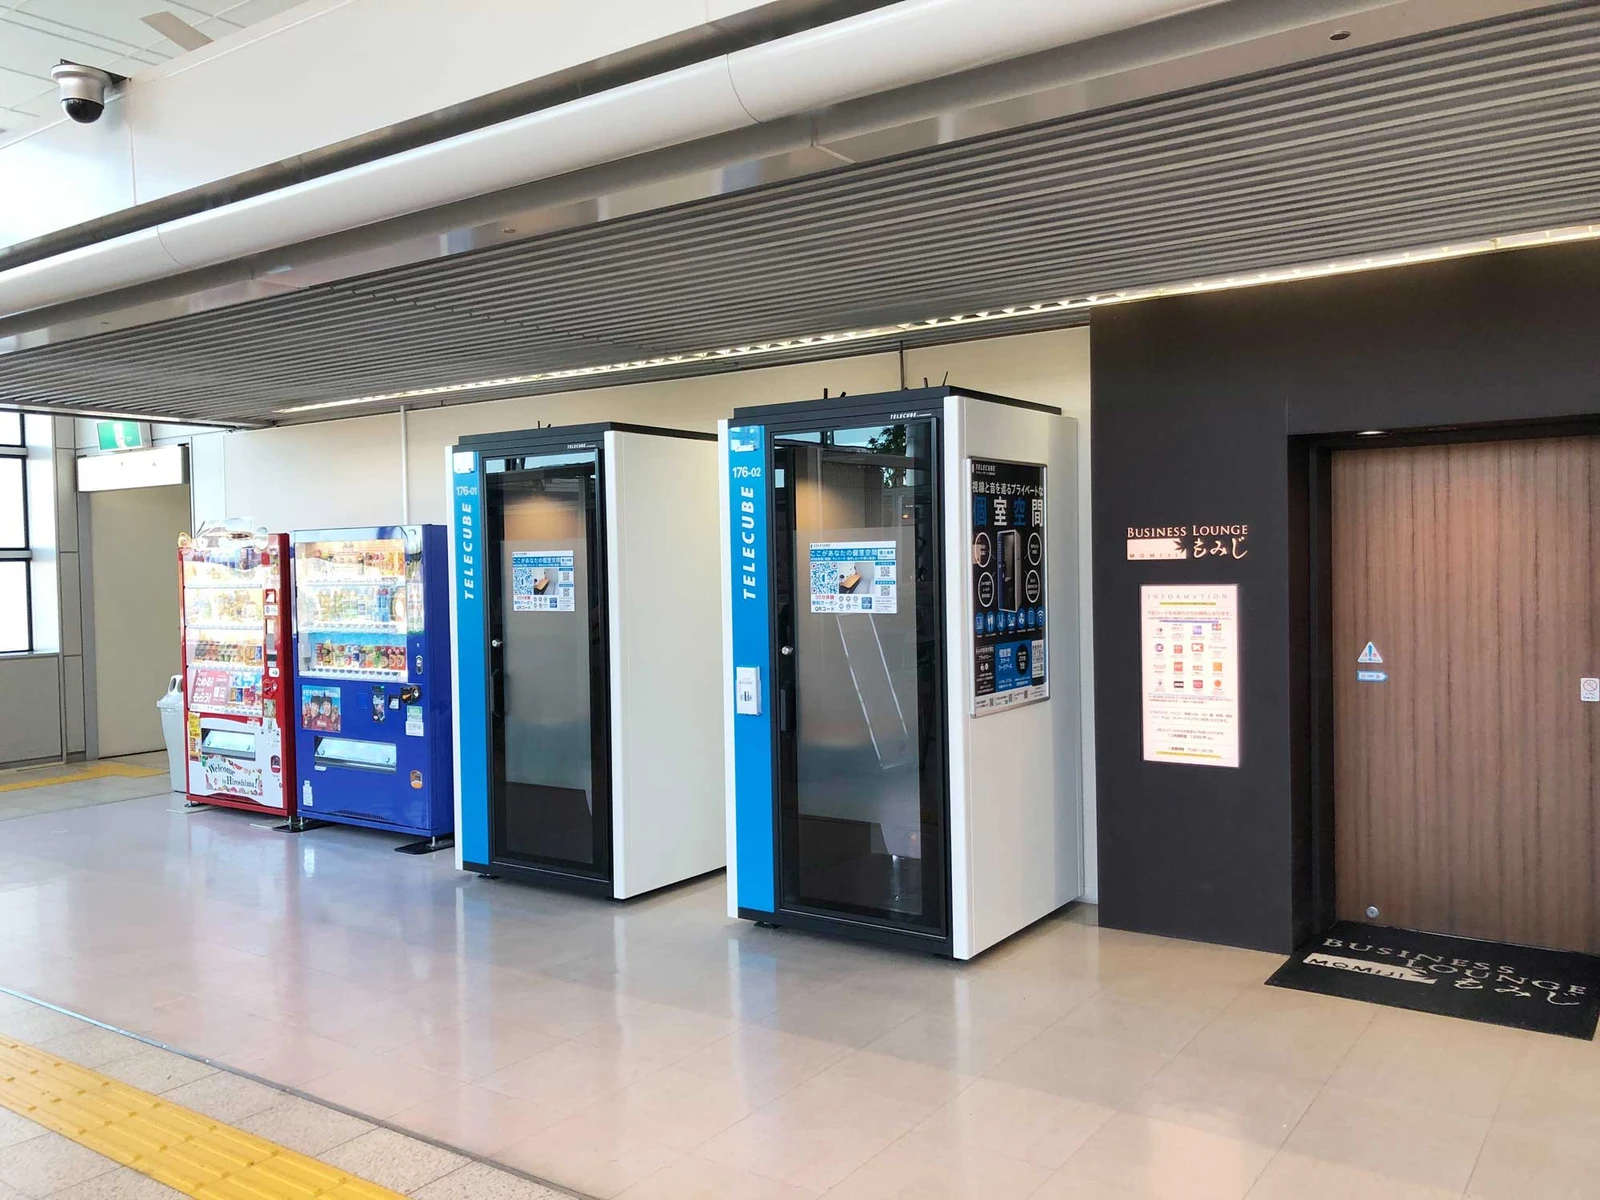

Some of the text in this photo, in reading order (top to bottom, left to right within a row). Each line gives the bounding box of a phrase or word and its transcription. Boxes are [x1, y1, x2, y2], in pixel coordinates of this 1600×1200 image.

[732, 466, 761, 478] 176-02
[456, 486, 477, 496] 176-01
[973, 495, 1044, 528] 個室空間
[741, 486, 756, 600] TELECUBE
[1127, 525, 1248, 538] BUSINESS LOUNGE
[462, 502, 474, 600] TELECUBE
[1193, 536, 1248, 560] もみじ
[208, 763, 236, 776] Welcome
[226, 775, 258, 788] Hiroshima!
[1323, 937, 1515, 974] BUSINESS
[1309, 957, 1404, 980] MOMIJI
[1405, 958, 1587, 996] LOUNGE
[1454, 977, 1581, 1006] もみじ
